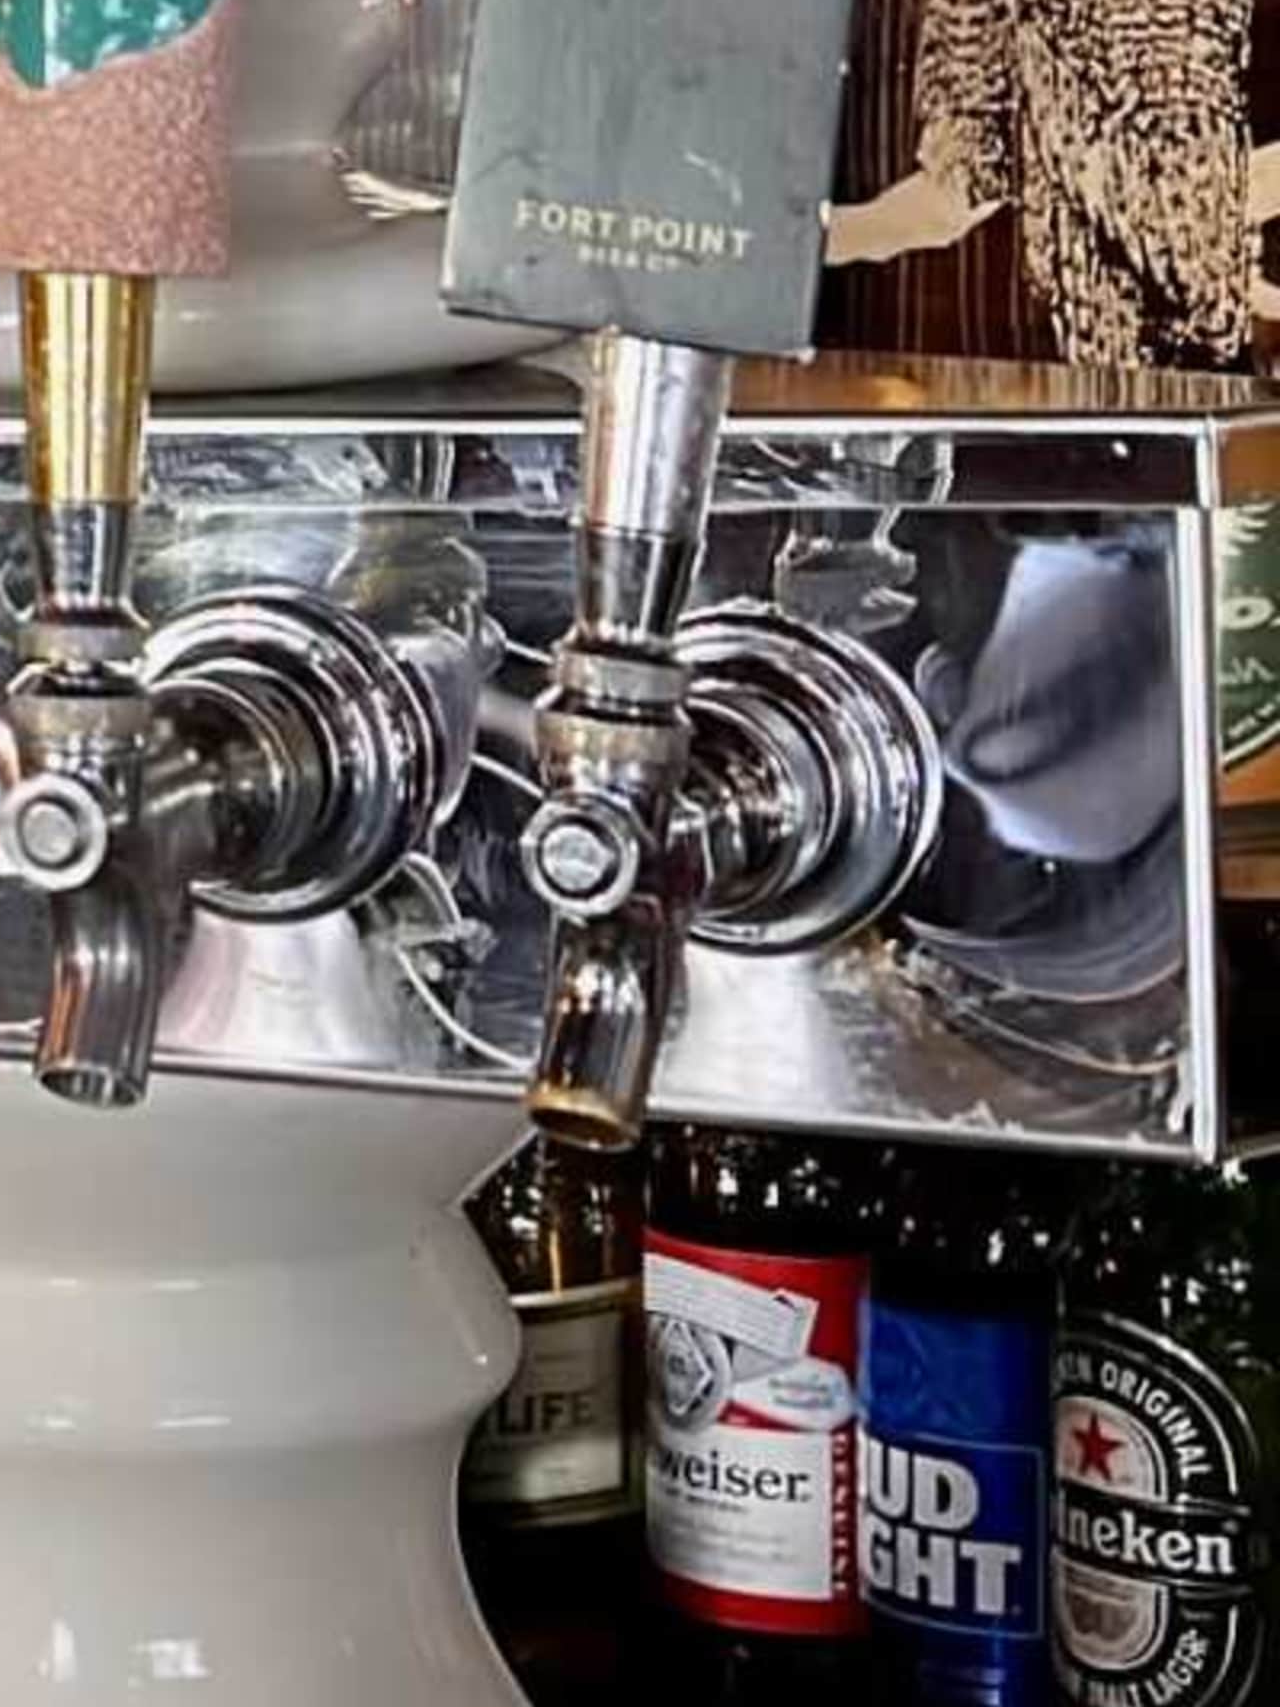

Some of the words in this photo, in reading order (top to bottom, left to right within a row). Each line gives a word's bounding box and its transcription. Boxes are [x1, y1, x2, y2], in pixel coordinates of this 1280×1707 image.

[514, 198, 619, 240] FORT
[628, 215, 755, 260] POINT
[496, 1389, 600, 1434] LIFE
[1099, 1358, 1213, 1482] ORIGINAL
